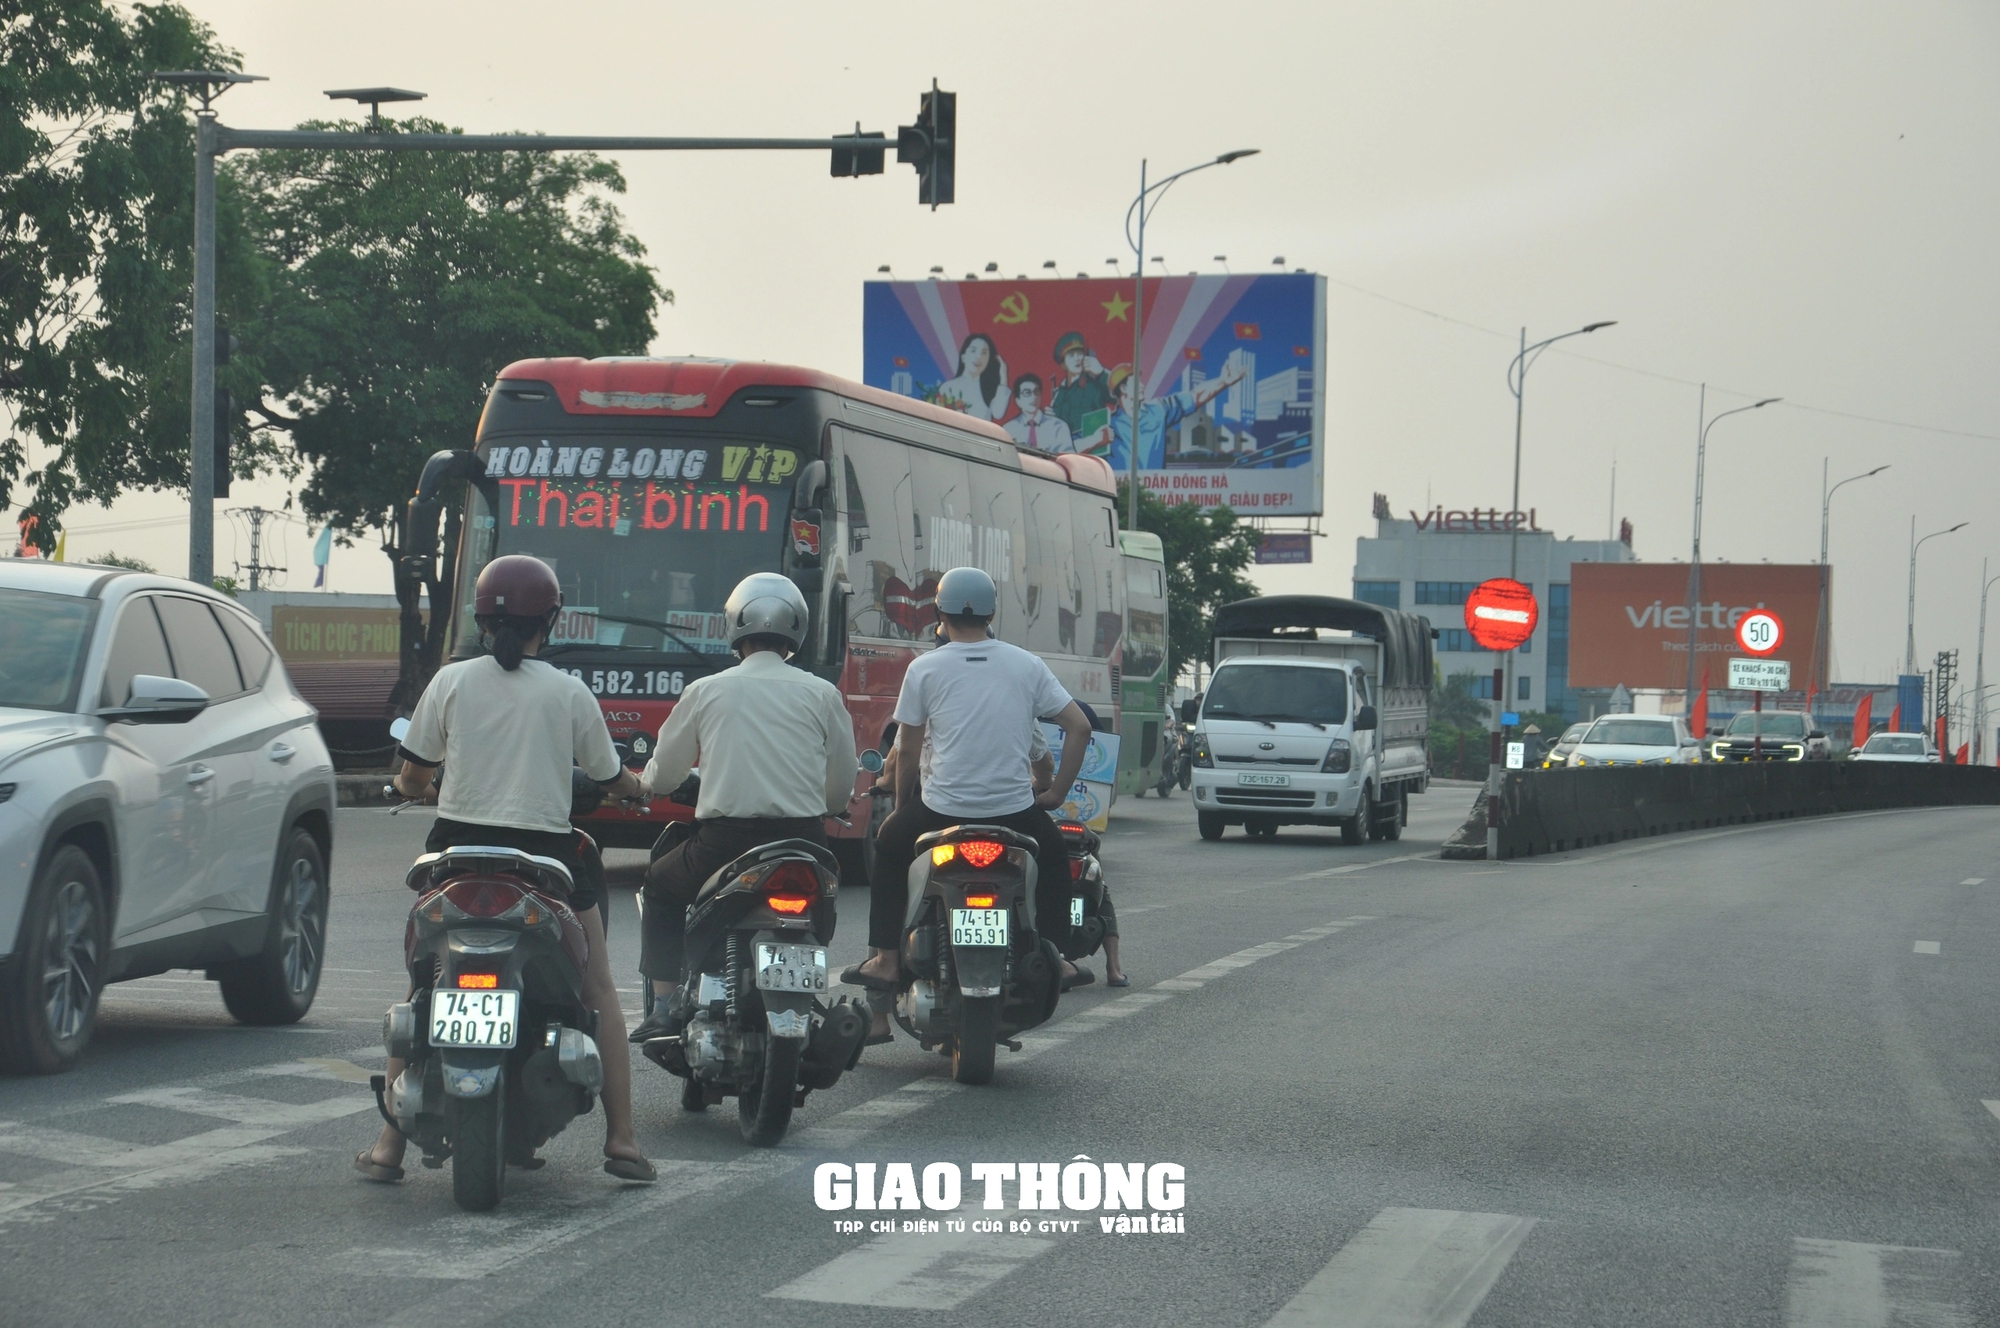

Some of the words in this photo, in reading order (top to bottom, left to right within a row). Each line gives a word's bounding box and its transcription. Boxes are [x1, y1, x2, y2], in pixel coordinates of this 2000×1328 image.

[484, 440, 604, 478] HOÀNG
[607, 447, 707, 480] LONG
[1144, 473, 1168, 488] DÂN
[1173, 473, 1207, 488] ĐÔNG
[1211, 472, 1228, 488] HÀ
[499, 478, 621, 529] Thái
[641, 481, 770, 532] bình
[1230, 491, 1259, 506] GIÀU
[1263, 493, 1293, 509] ĐẸP!
[1409, 504, 1543, 531] viettel
[1625, 600, 1766, 629] viette
[284, 616, 321, 651] TÍCH
[325, 620, 357, 658] CỰC
[1750, 622, 1769, 642] 50
[960, 910, 999, 926] 74-E1
[954, 928, 1005, 944] 055.91
[446, 993, 504, 1016] 74-C1
[433, 1019, 511, 1044] 280.78
